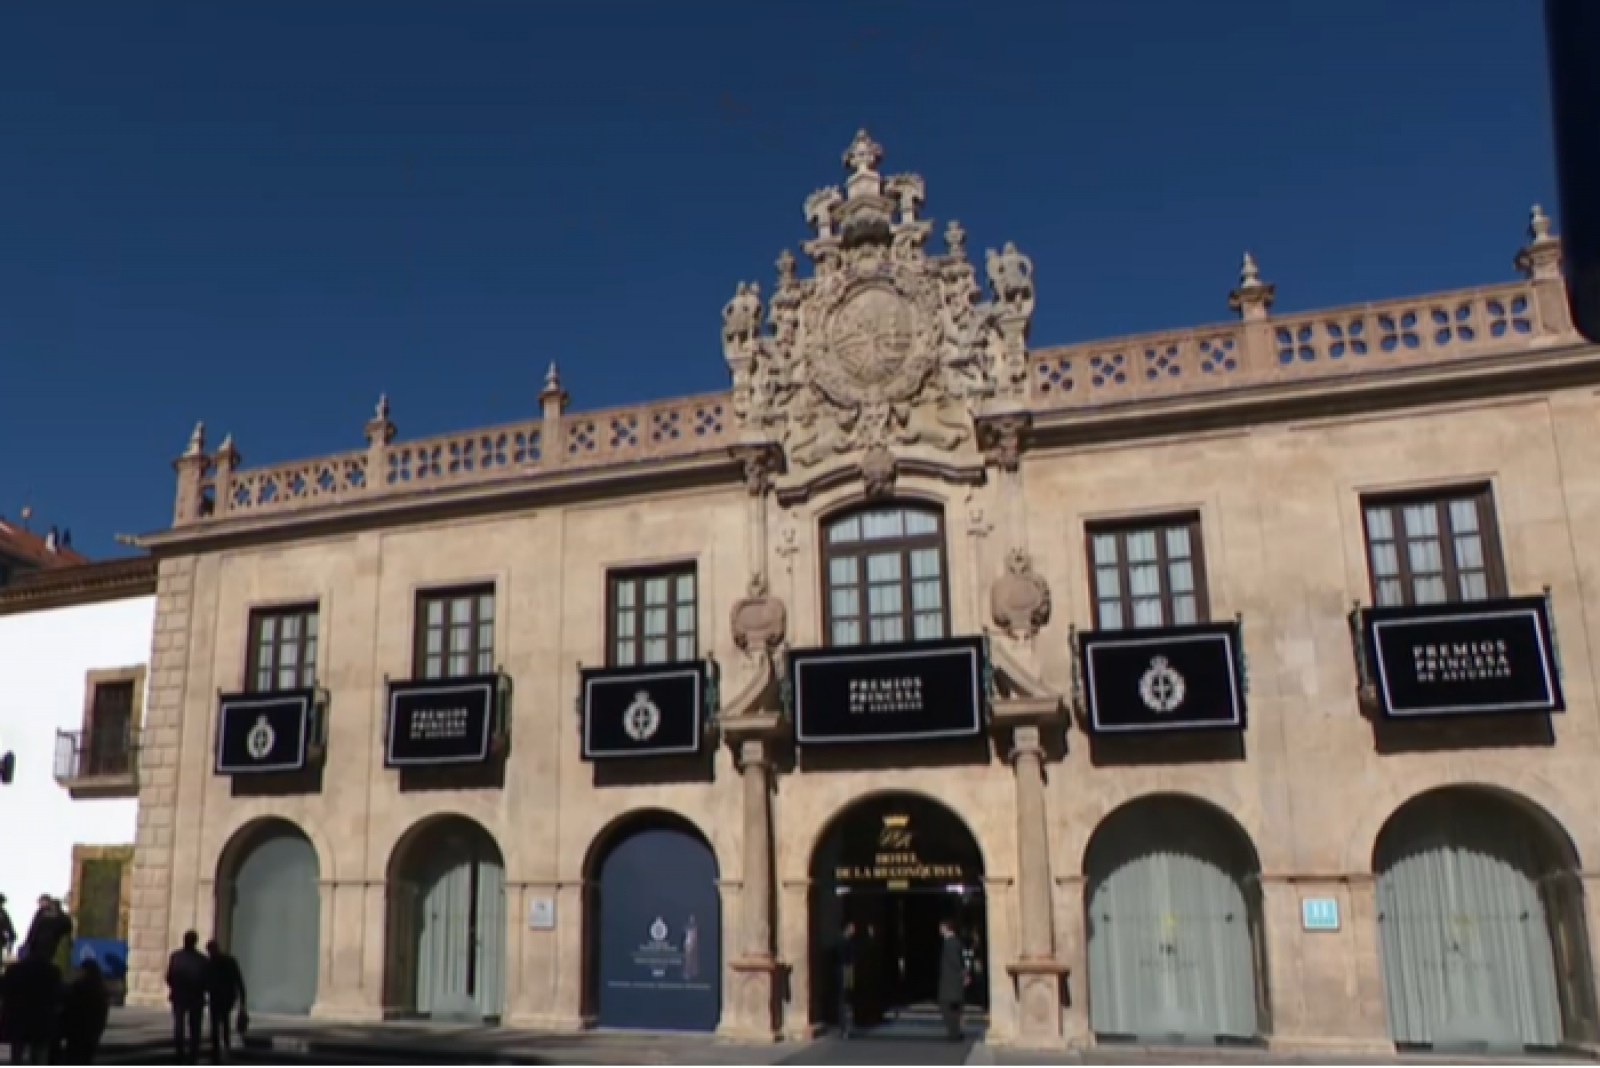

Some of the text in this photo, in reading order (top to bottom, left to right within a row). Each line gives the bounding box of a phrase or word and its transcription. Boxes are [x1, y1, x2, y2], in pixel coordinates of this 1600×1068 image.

[1412, 639, 1506, 656] PREMIOS
[1414, 654, 1508, 670] PRINCESA
[849, 677, 922, 691] PREMIOS
